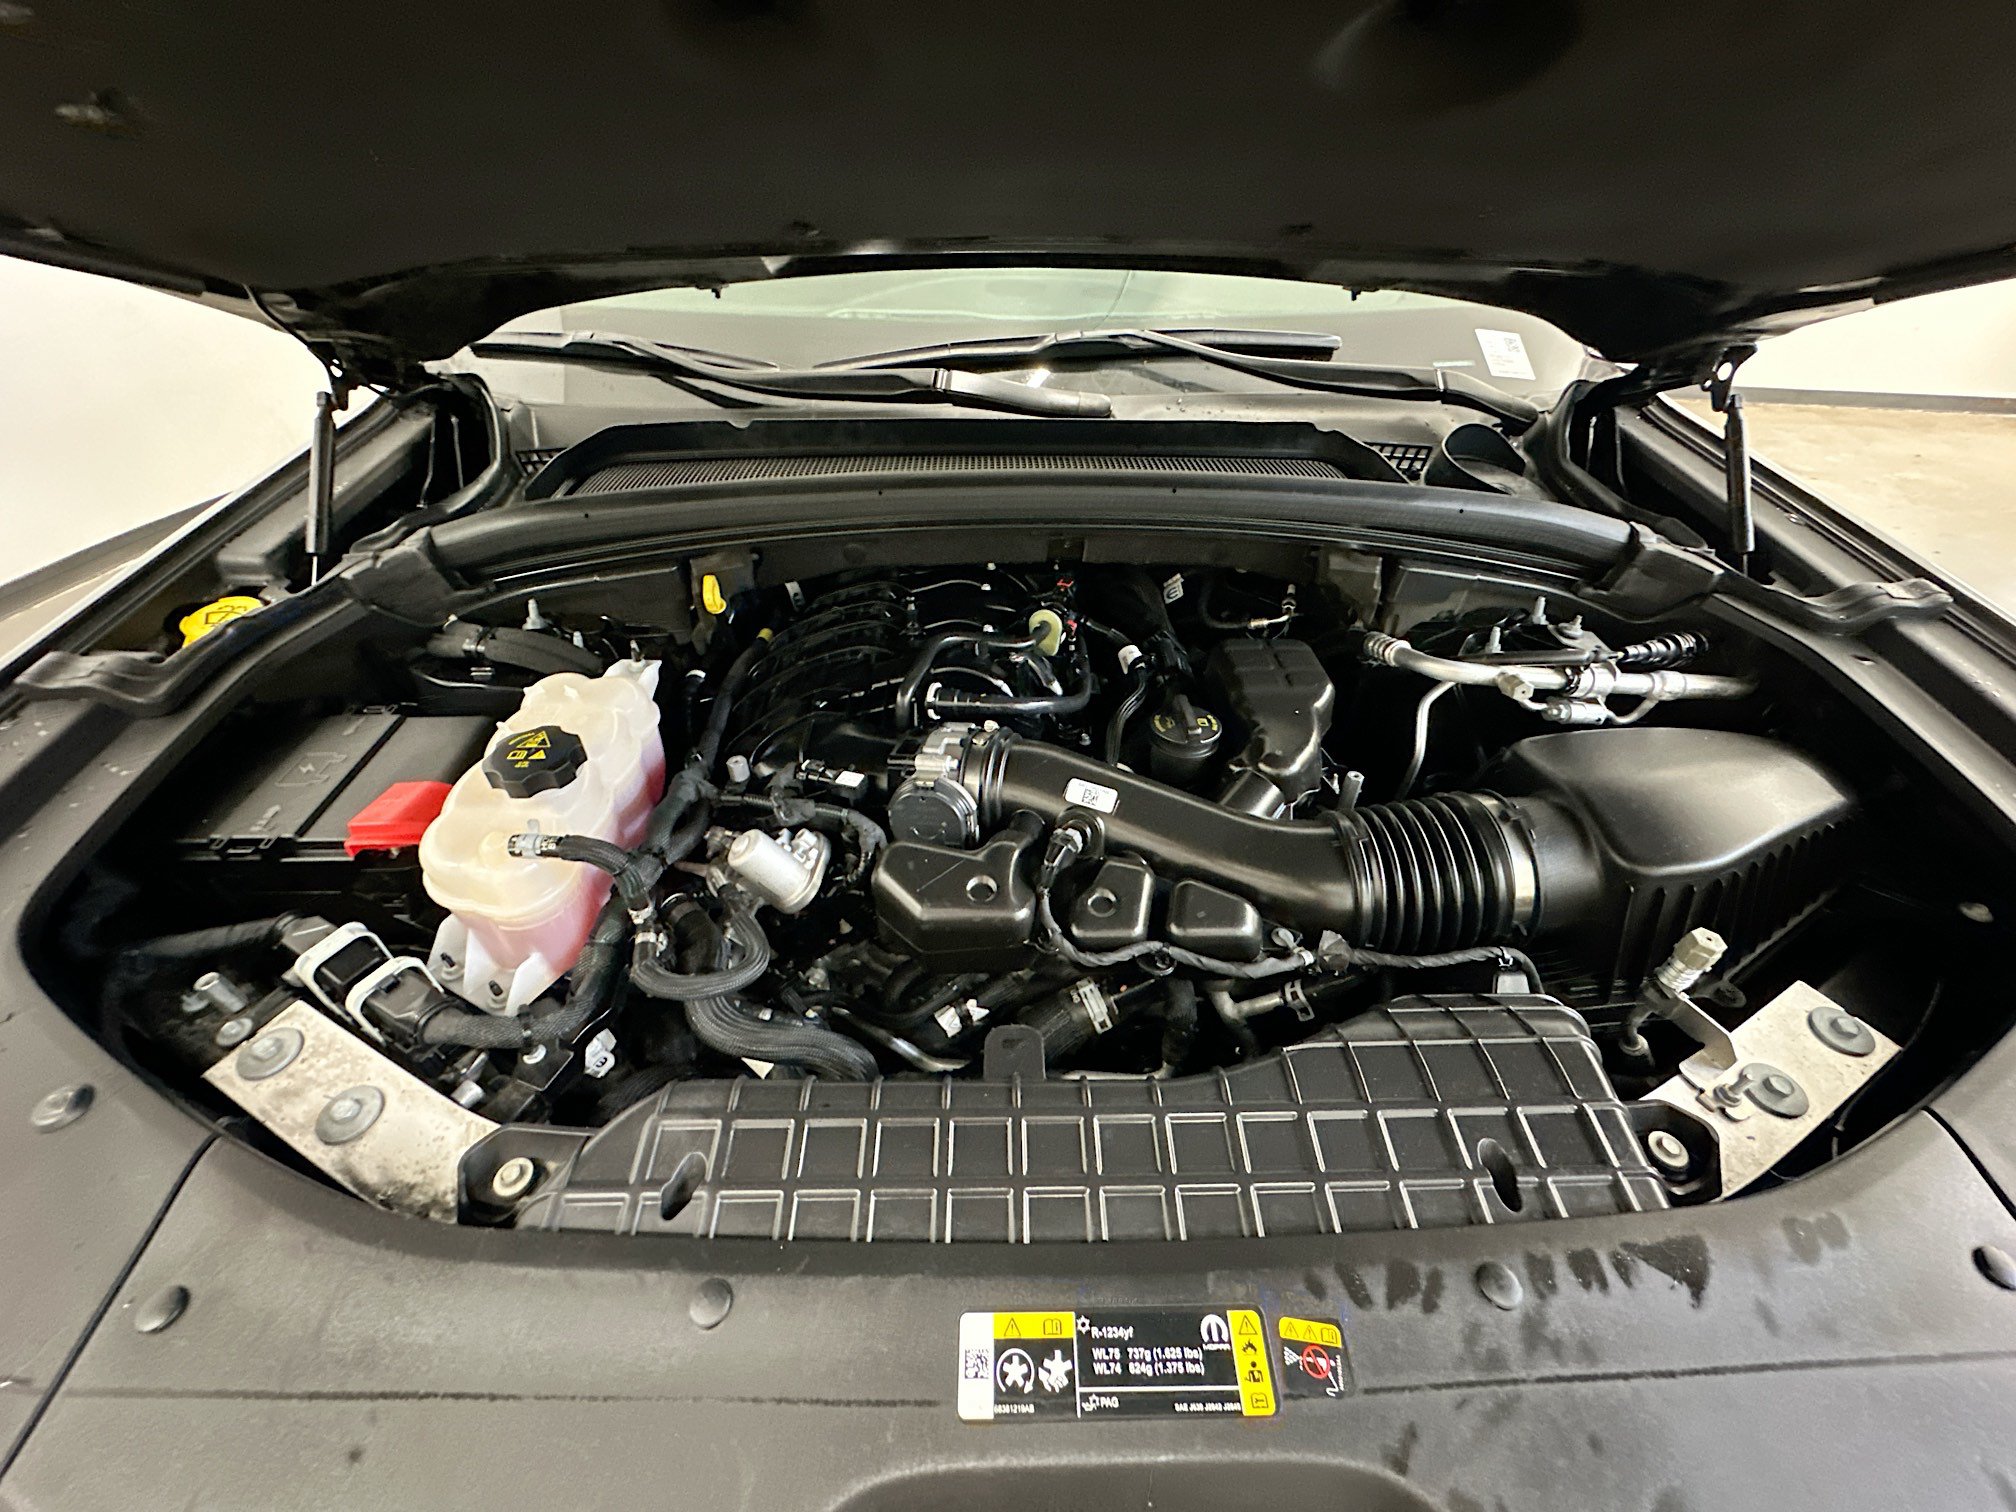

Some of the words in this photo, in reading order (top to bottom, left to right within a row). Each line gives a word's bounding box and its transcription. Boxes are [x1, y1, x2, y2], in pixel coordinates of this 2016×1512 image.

[1091, 1326, 1134, 1341] R-1234yf
[1127, 1347, 1151, 1362] 737g
[1184, 1347, 1203, 1362] lbs)
[1092, 1362, 1122, 1375] WL74
[1154, 1362, 1184, 1376] (1.375
[1185, 1362, 1205, 1376] lbs)
[1100, 1396, 1119, 1408] PAG
